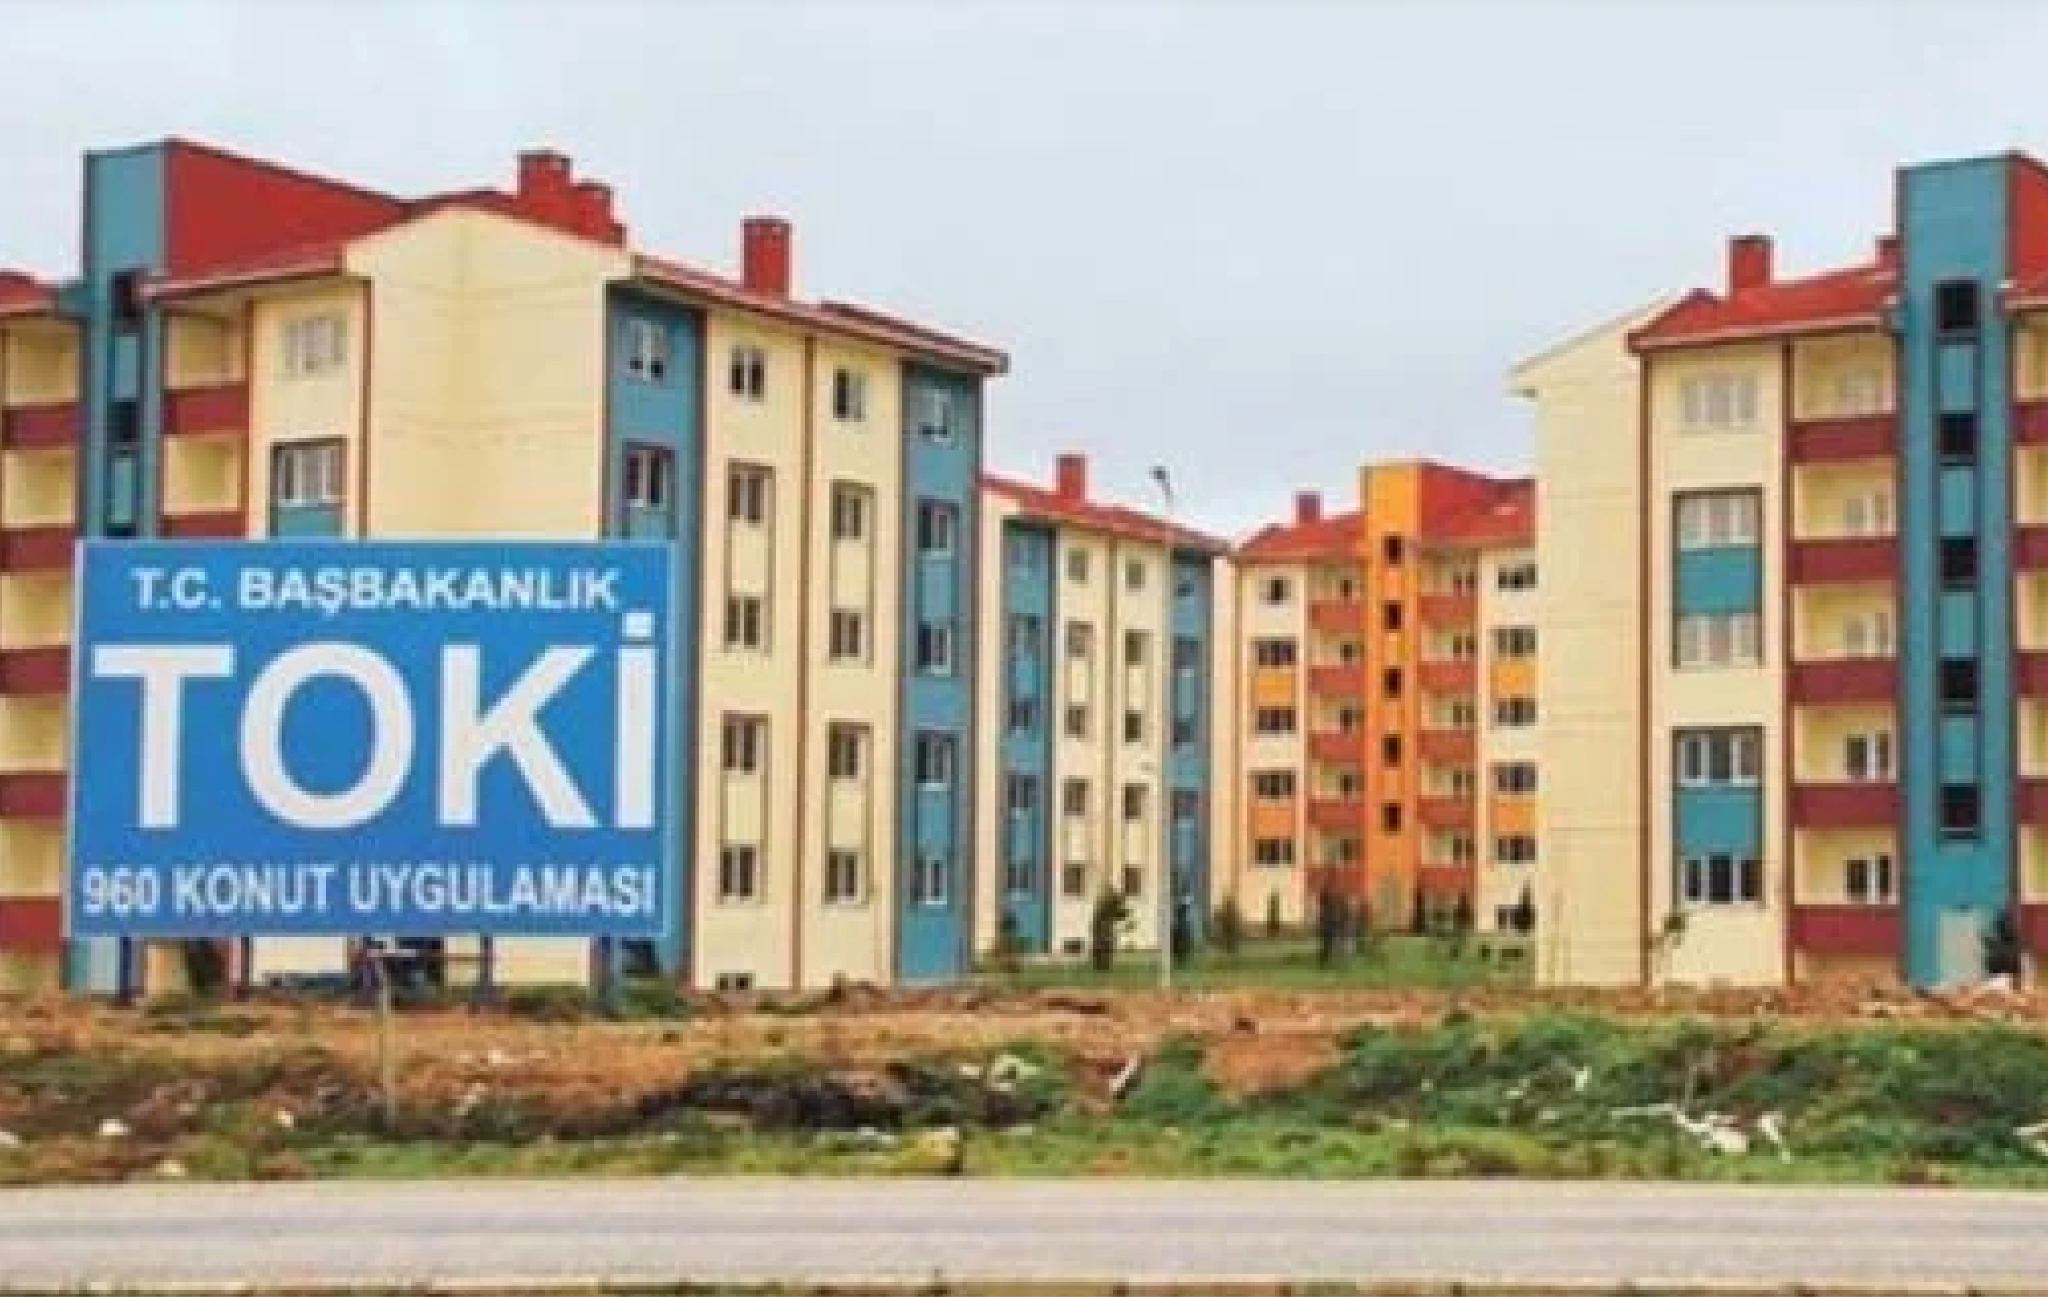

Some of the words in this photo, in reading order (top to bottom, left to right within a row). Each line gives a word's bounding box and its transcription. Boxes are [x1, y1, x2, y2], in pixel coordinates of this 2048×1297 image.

[132, 566, 222, 611] T.C.
[239, 566, 620, 615] BAŞBAKANLIK
[92, 611, 658, 830] TOKİ
[82, 865, 160, 915] 960
[173, 864, 335, 914] KONUT
[349, 863, 657, 916] UYGULAMASI
